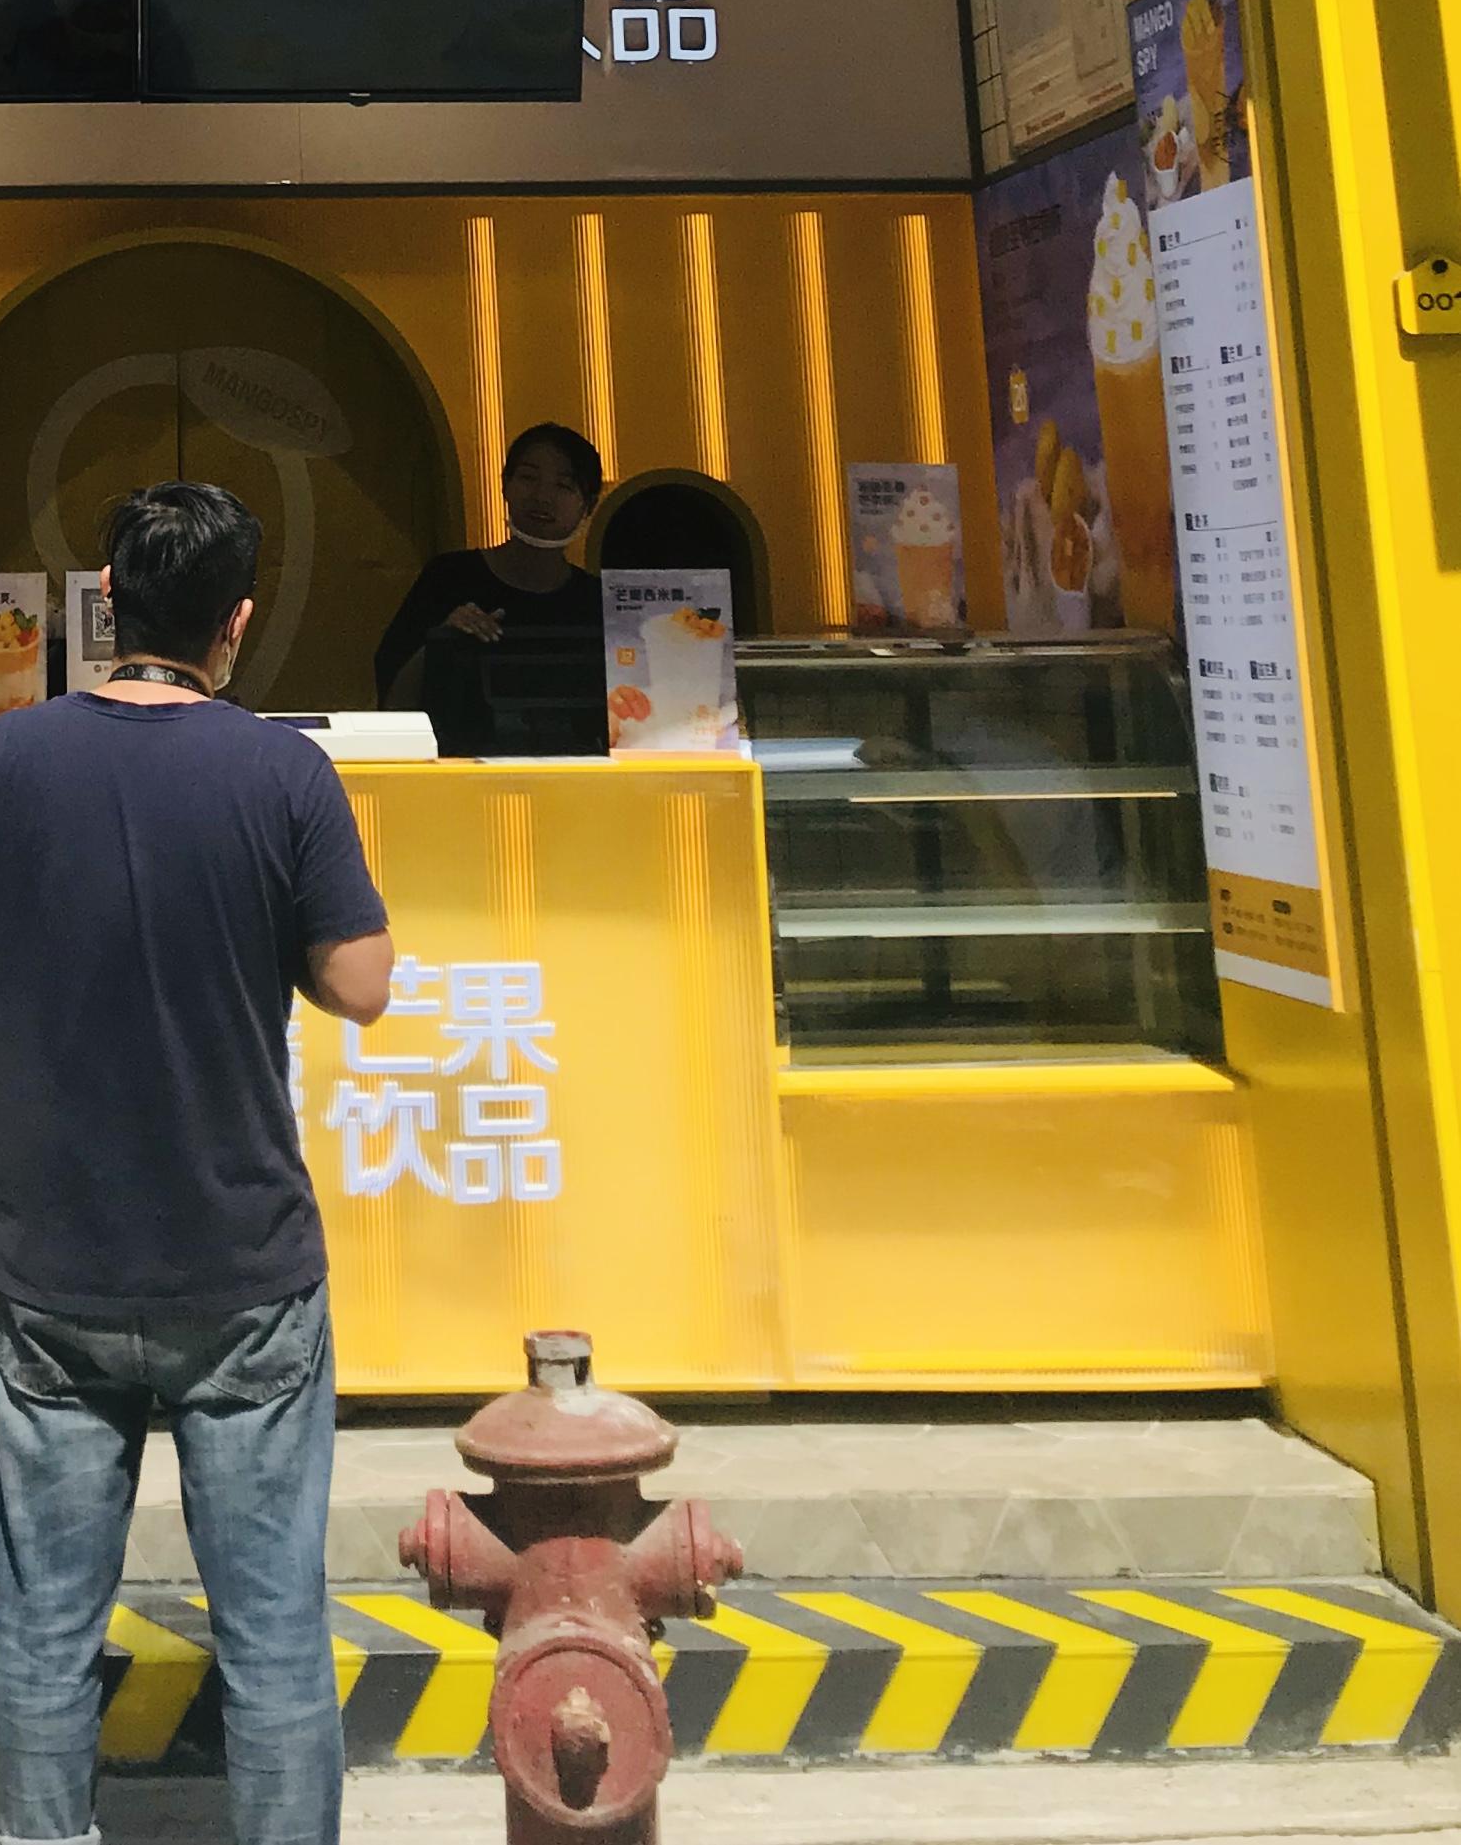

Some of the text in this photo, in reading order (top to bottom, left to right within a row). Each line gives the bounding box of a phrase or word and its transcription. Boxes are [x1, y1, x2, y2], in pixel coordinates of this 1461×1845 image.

[1418, 292, 1461, 311] 00
[342, 955, 559, 1081] 芒果
[323, 1080, 561, 1204] 饮品
